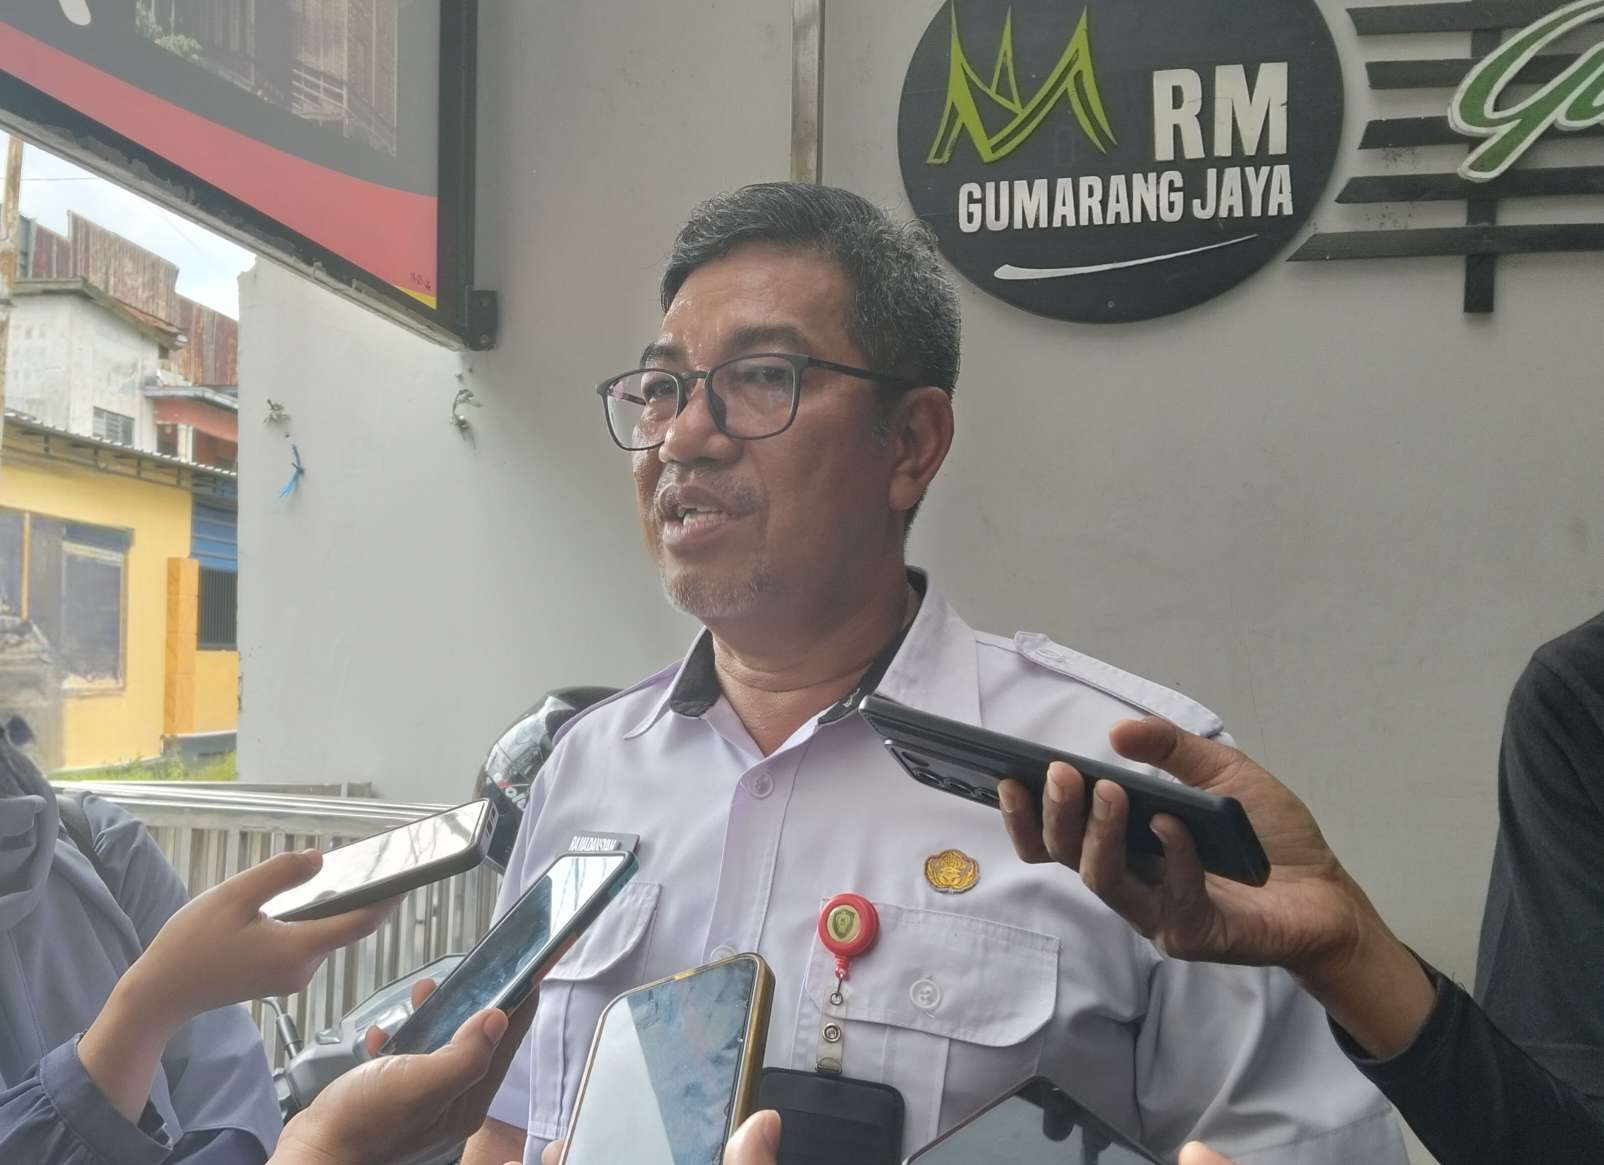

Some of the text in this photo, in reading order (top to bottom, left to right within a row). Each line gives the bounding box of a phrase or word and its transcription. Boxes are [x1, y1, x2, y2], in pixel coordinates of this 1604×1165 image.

[1153, 62, 1288, 161] RM
[958, 164, 1293, 233] GUMARANG JAYA
